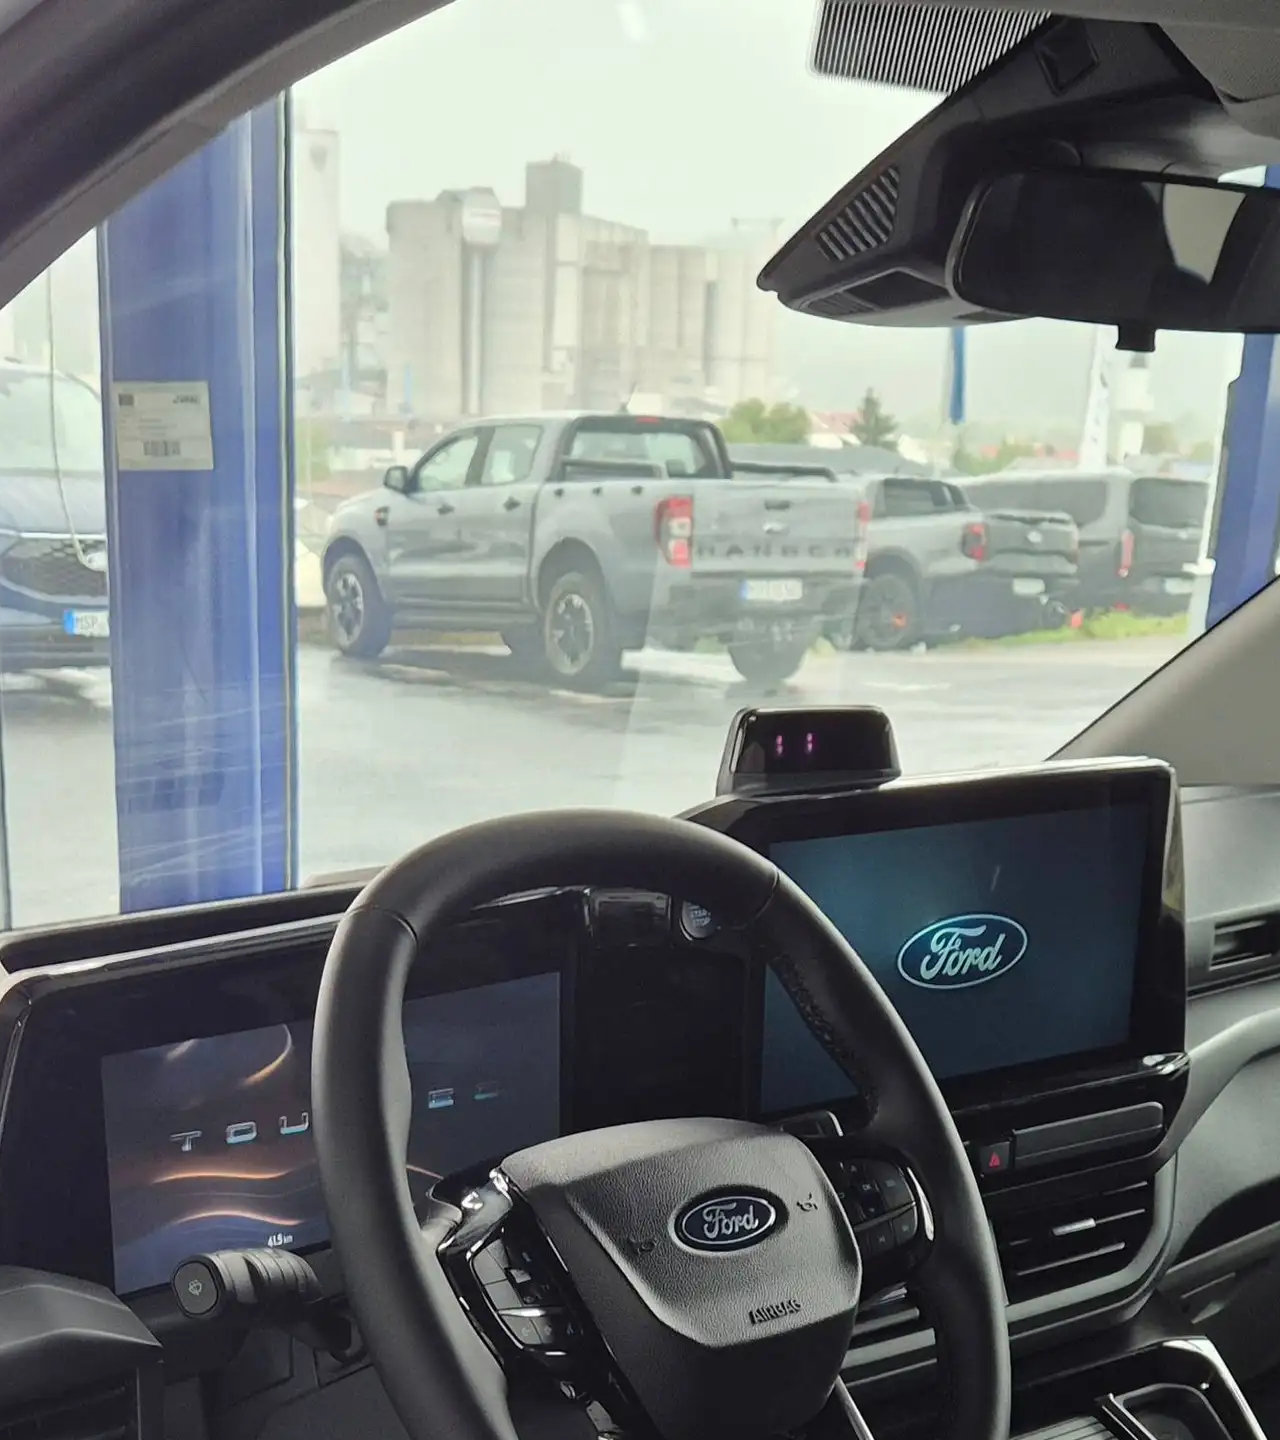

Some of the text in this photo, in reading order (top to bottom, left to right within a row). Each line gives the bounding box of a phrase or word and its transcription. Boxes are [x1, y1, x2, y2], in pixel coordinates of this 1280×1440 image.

[920, 924, 1006, 980] Ford
[703, 1202, 759, 1239] Ford
[748, 1299, 801, 1325] AIRBAG
